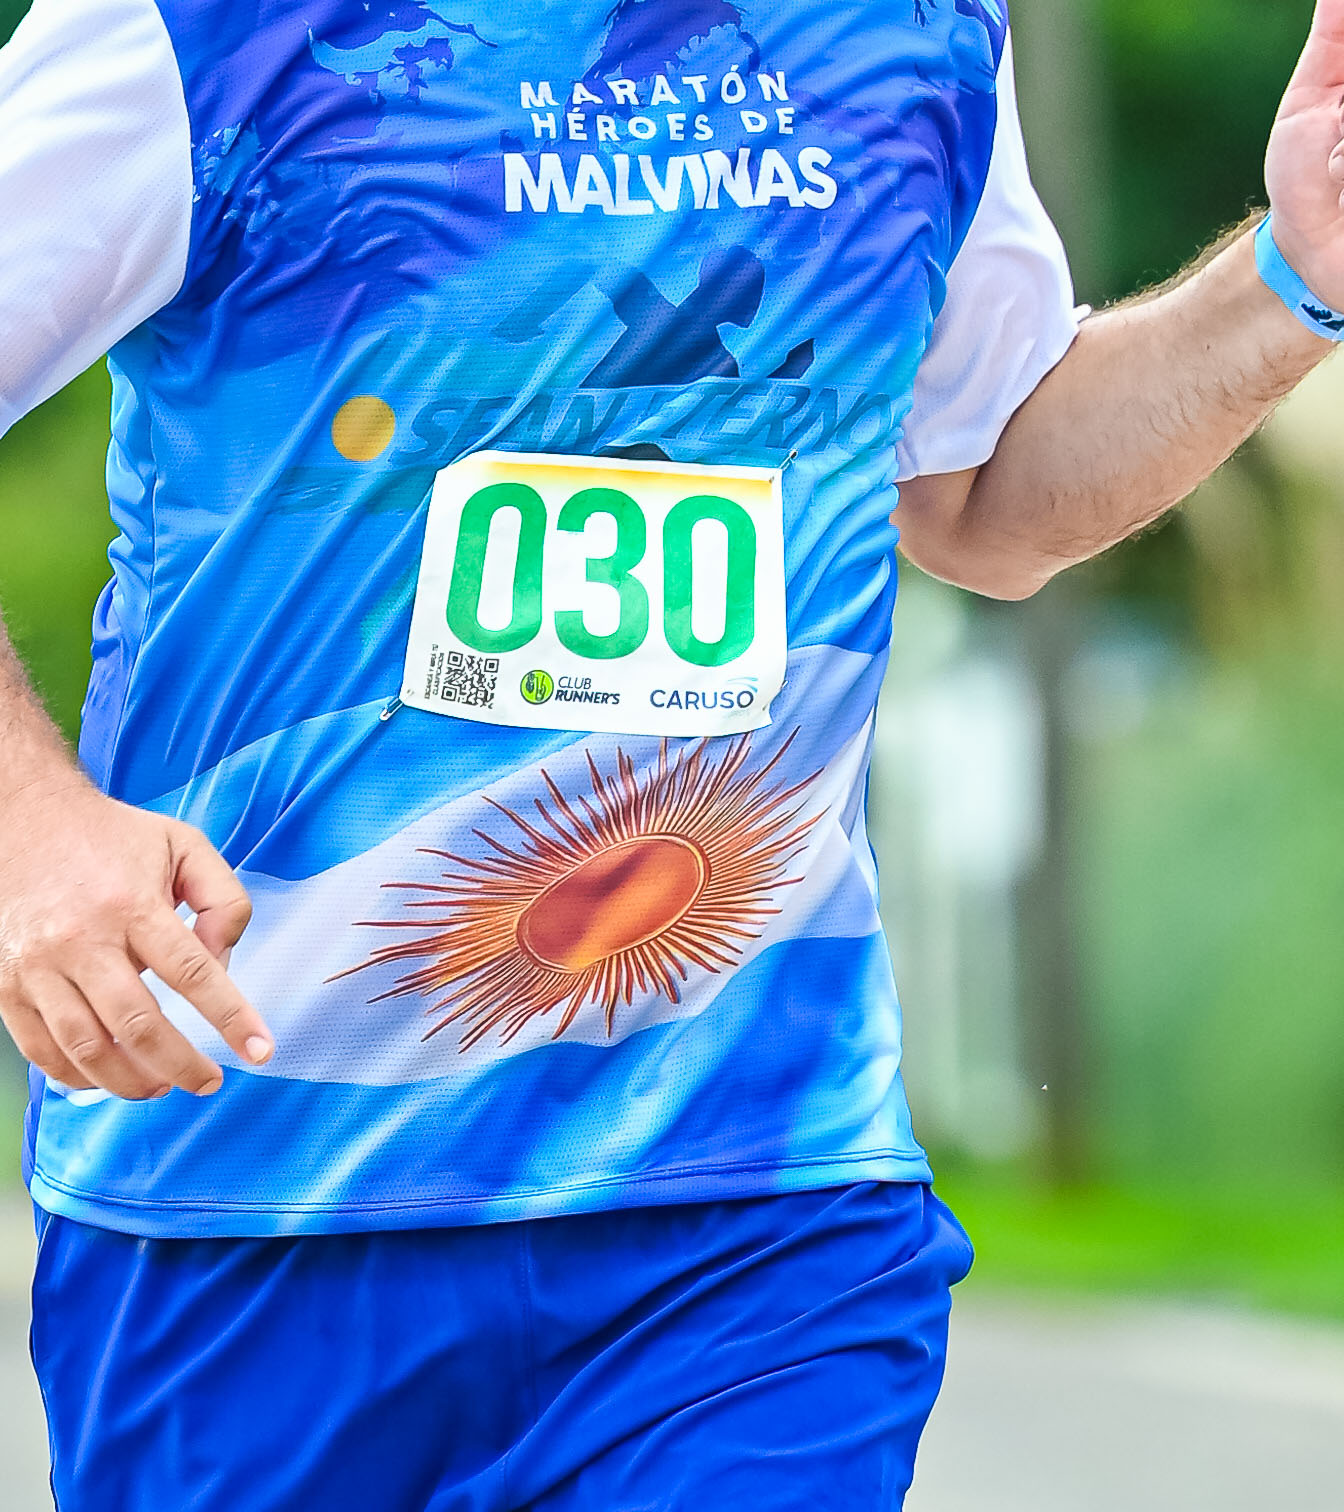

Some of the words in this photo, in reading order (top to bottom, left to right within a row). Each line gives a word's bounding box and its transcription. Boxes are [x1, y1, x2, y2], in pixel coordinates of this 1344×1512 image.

[520, 65, 789, 109] MARATÓN
[530, 108, 714, 142] HÉROES
[740, 107, 796, 135] DE
[503, 146, 838, 216] MALVINAS
[446, 482, 757, 667] 030
[554, 690, 621, 705] RUNNER'S
[558, 676, 592, 689] CLUB
[650, 689, 754, 710] CARUSO
